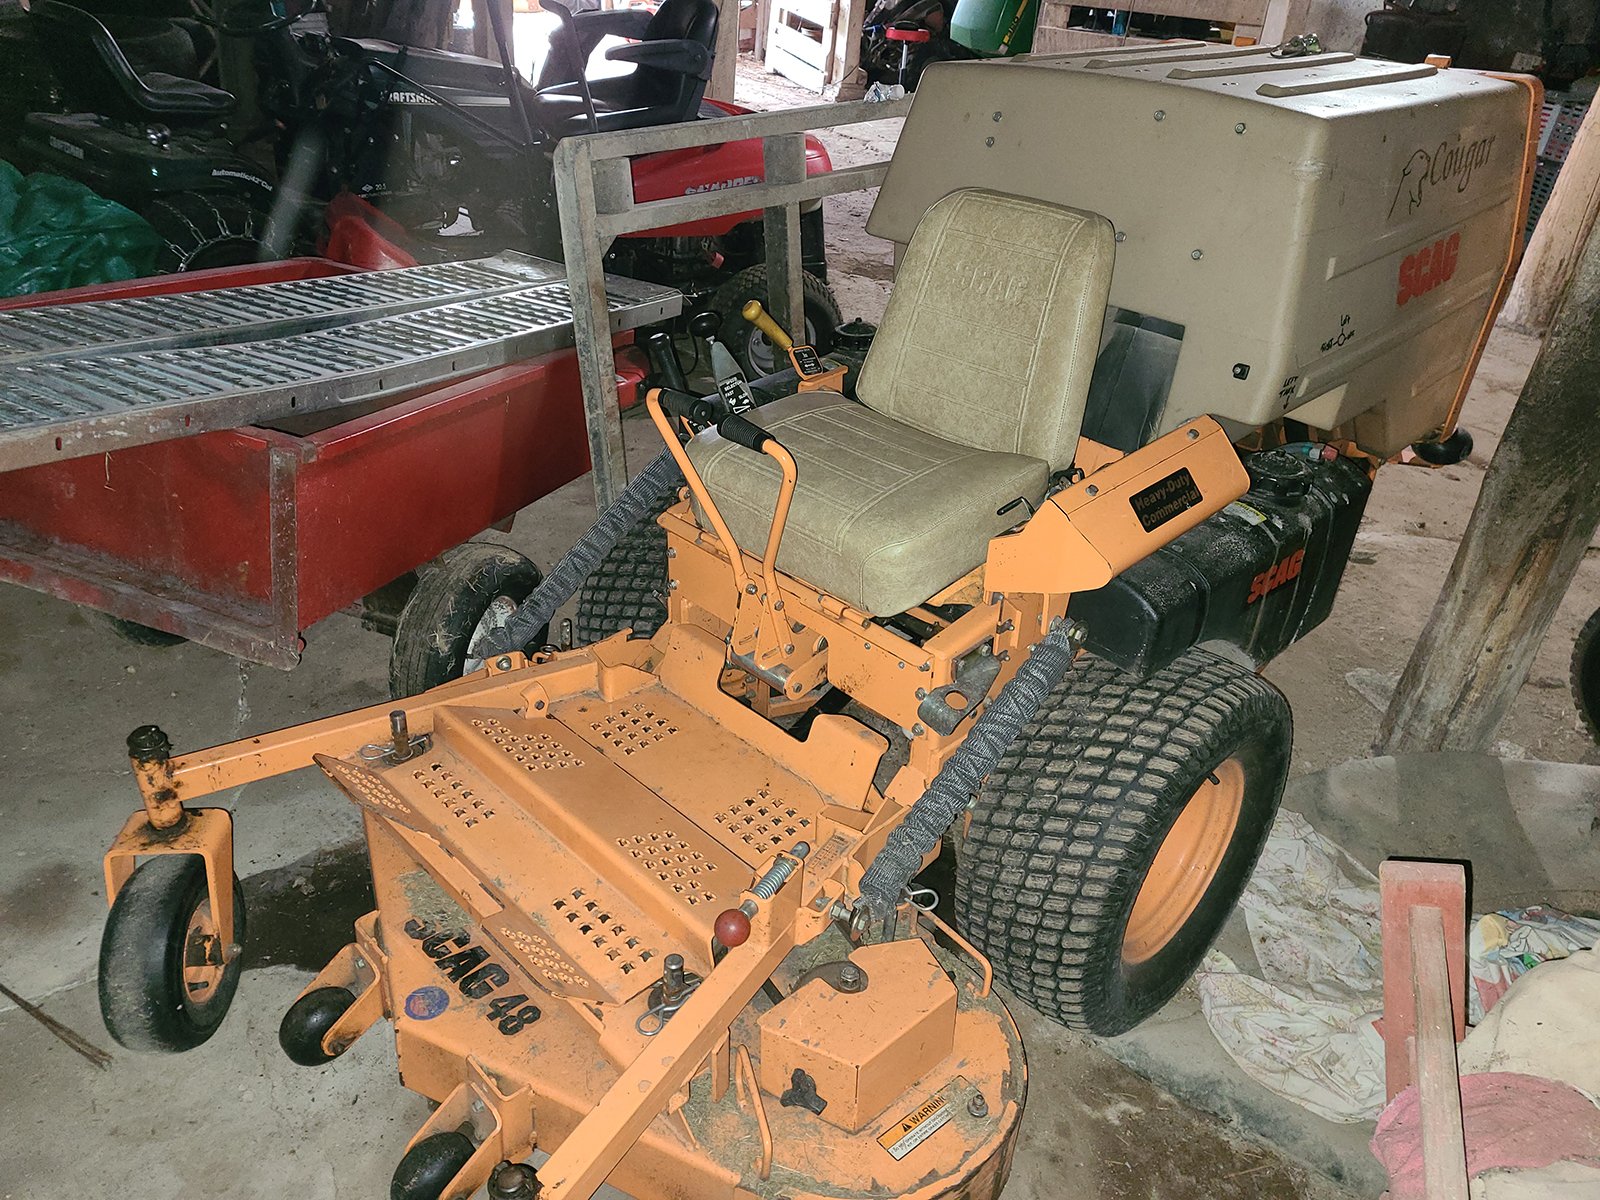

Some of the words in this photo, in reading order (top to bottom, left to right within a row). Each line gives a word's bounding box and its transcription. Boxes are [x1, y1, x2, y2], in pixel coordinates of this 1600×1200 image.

[1430, 135, 1496, 193] Cougar
[1396, 230, 1461, 306] SCAG
[1135, 474, 1191, 512] Heavy-Duty
[1142, 485, 1200, 528] Commercial
[1247, 548, 1305, 604] SCAG
[486, 993, 541, 1036] 48
